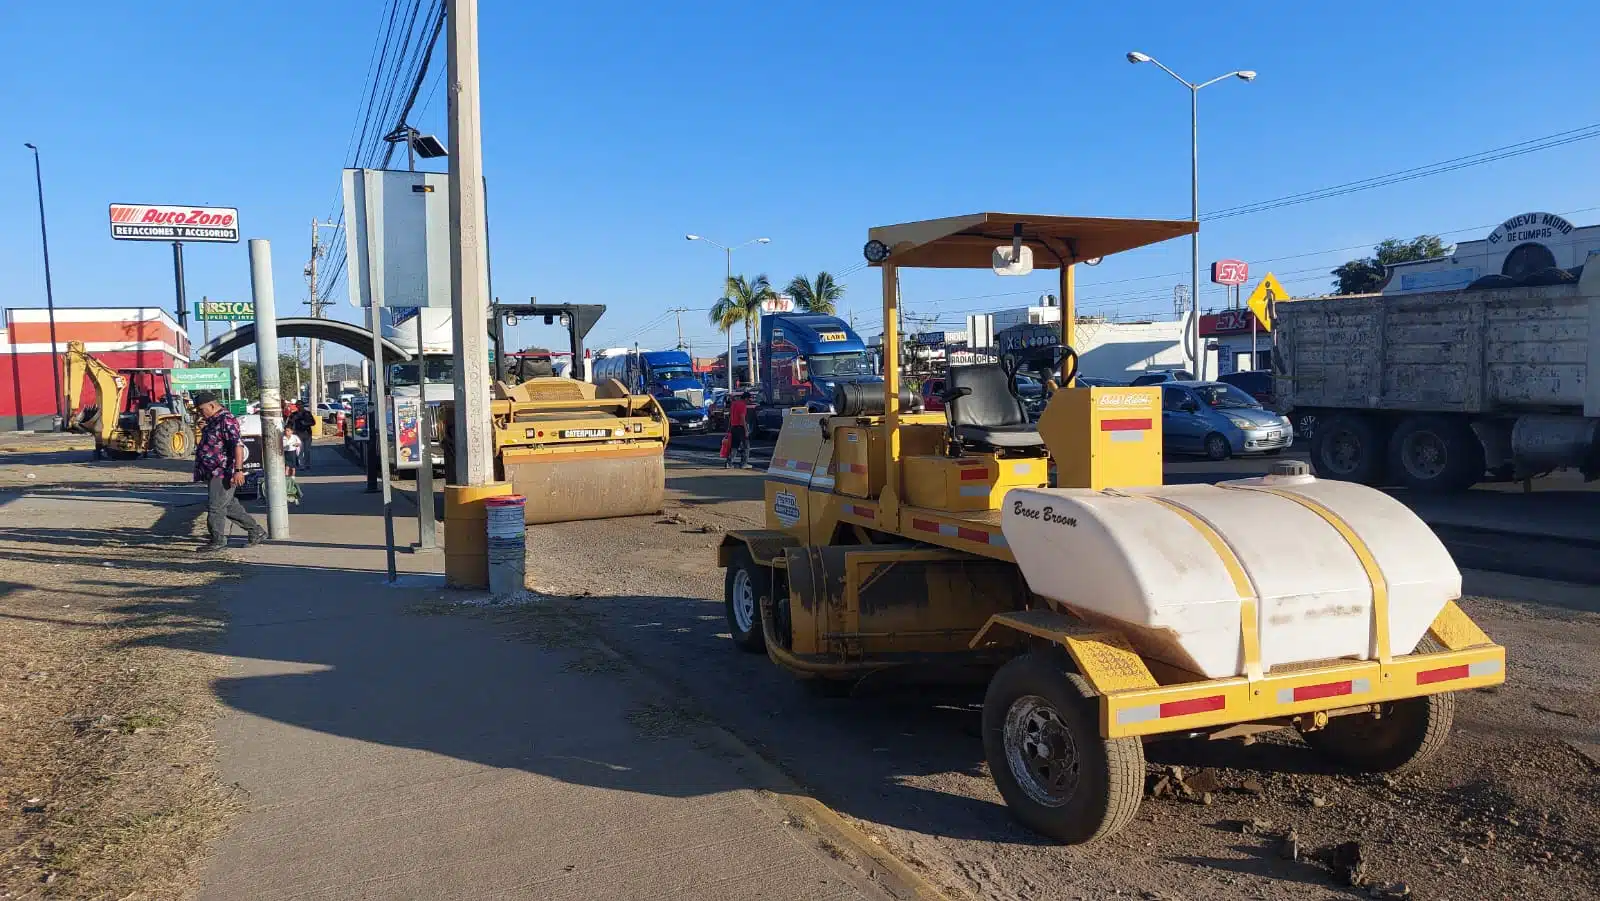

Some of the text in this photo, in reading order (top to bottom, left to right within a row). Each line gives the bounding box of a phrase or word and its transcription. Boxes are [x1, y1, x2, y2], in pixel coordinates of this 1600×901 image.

[141, 208, 234, 227] AutoZone
[116, 226, 234, 238] REFACCIONES Y ACCESORIOS
[1488, 213, 1573, 245] EL NUEVO MORO
[1507, 228, 1552, 242] DE CUMPAS
[565, 429, 606, 438] CATERPILLAR
[1013, 501, 1077, 527] Broce Broom
